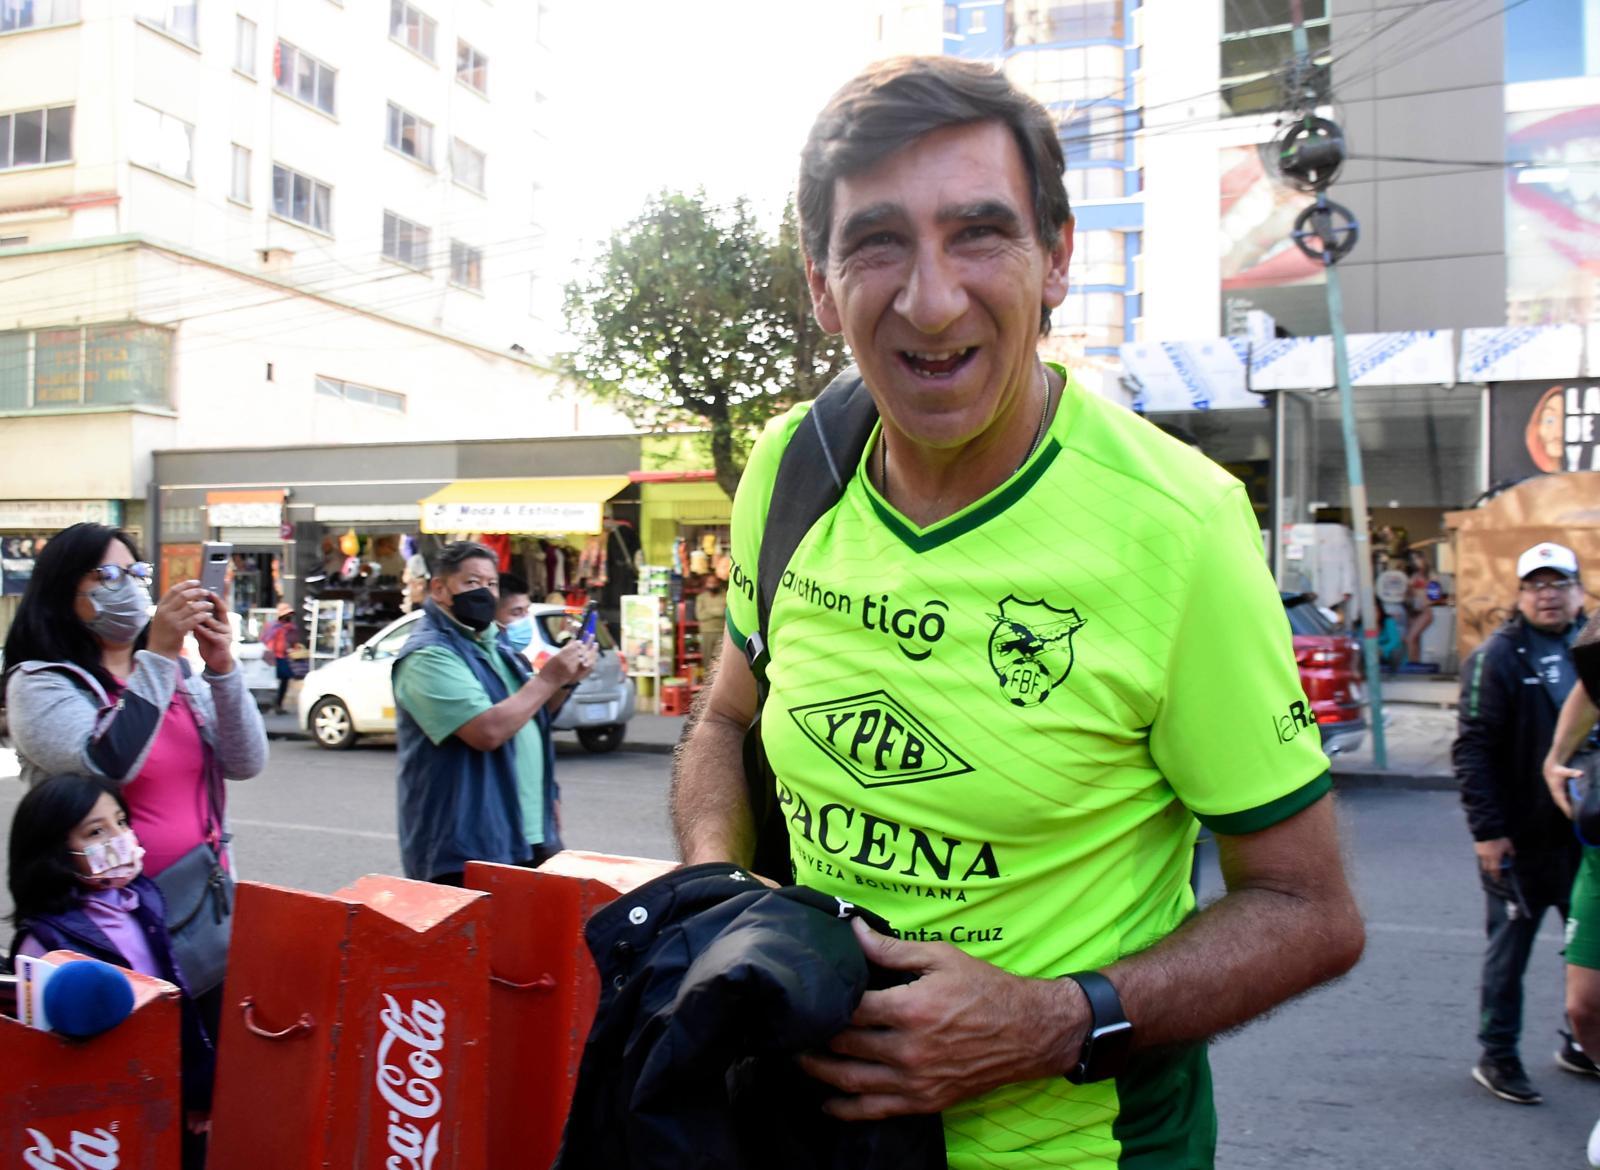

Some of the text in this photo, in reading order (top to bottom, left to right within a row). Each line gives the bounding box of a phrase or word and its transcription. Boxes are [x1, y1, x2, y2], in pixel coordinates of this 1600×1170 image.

[1010, 669, 1041, 695] FBF
[825, 708, 926, 772] YPFB
[855, 874, 967, 903] BOLIVIANA
[949, 925, 1004, 943] Cruz
